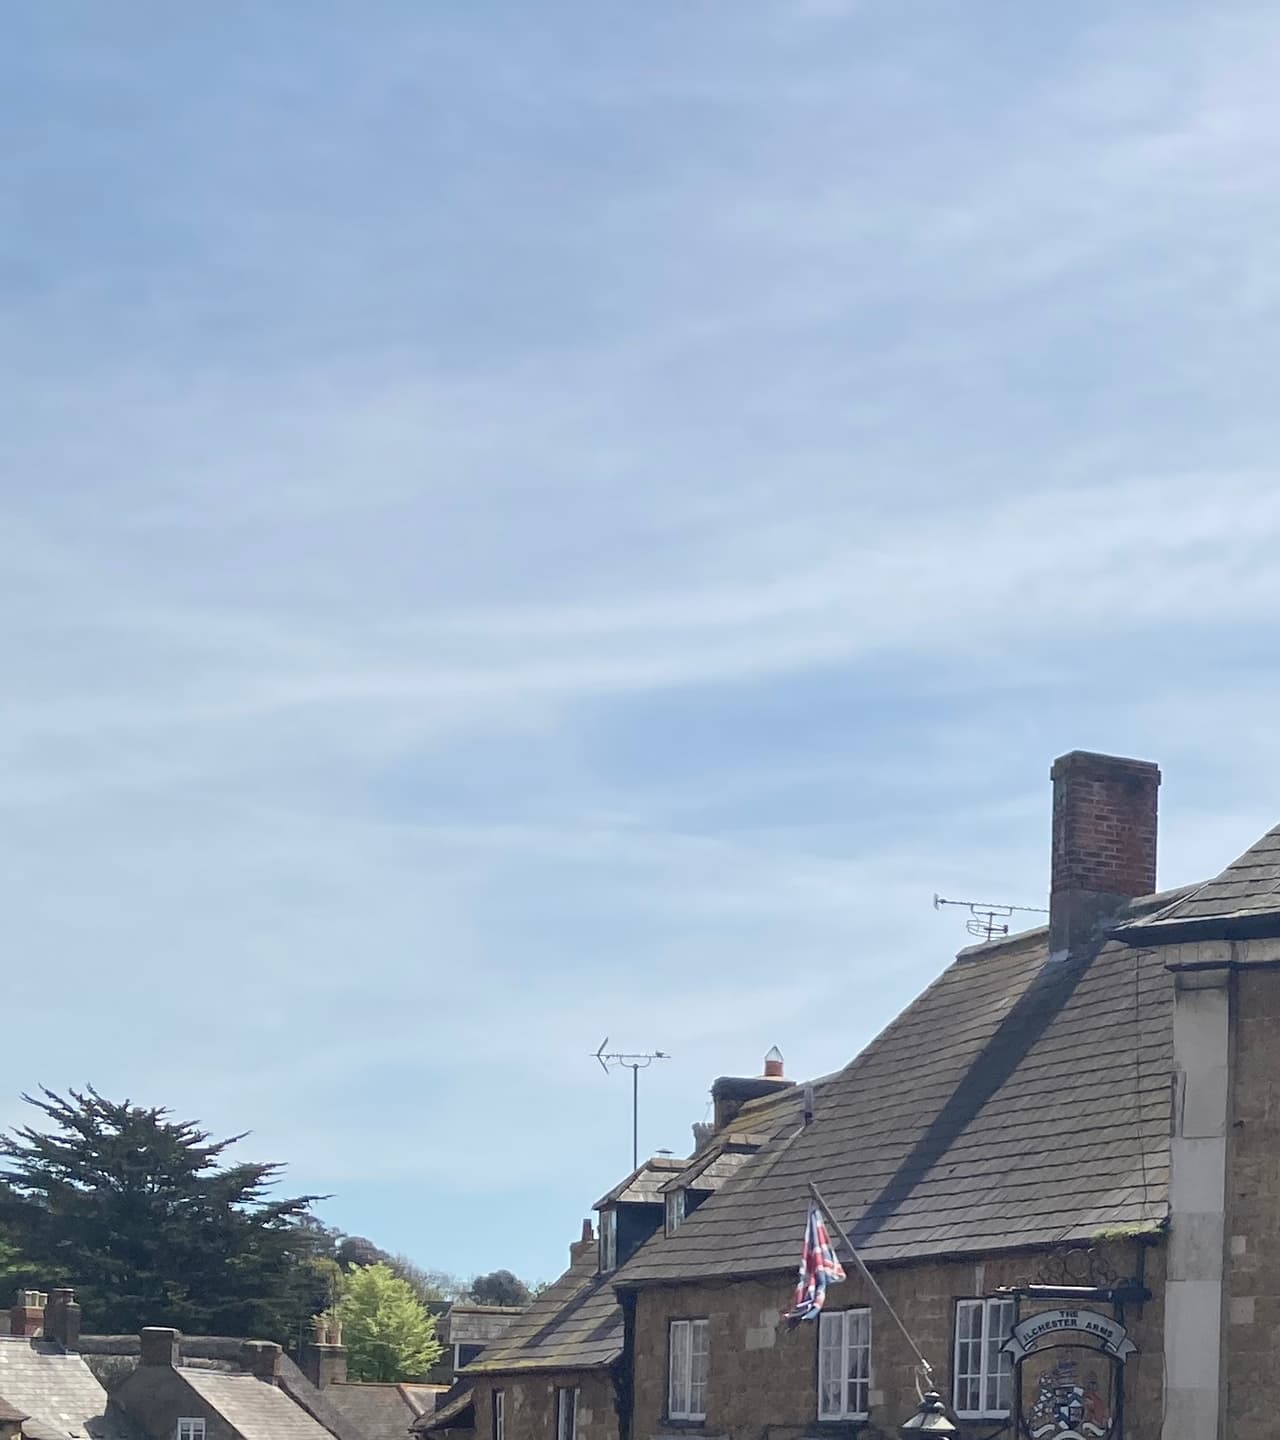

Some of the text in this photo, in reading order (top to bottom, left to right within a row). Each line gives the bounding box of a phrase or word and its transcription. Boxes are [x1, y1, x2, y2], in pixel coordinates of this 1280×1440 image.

[1059, 1310, 1079, 1318] THE
[1023, 1318, 1114, 1342] ILCHESTER ARMS
